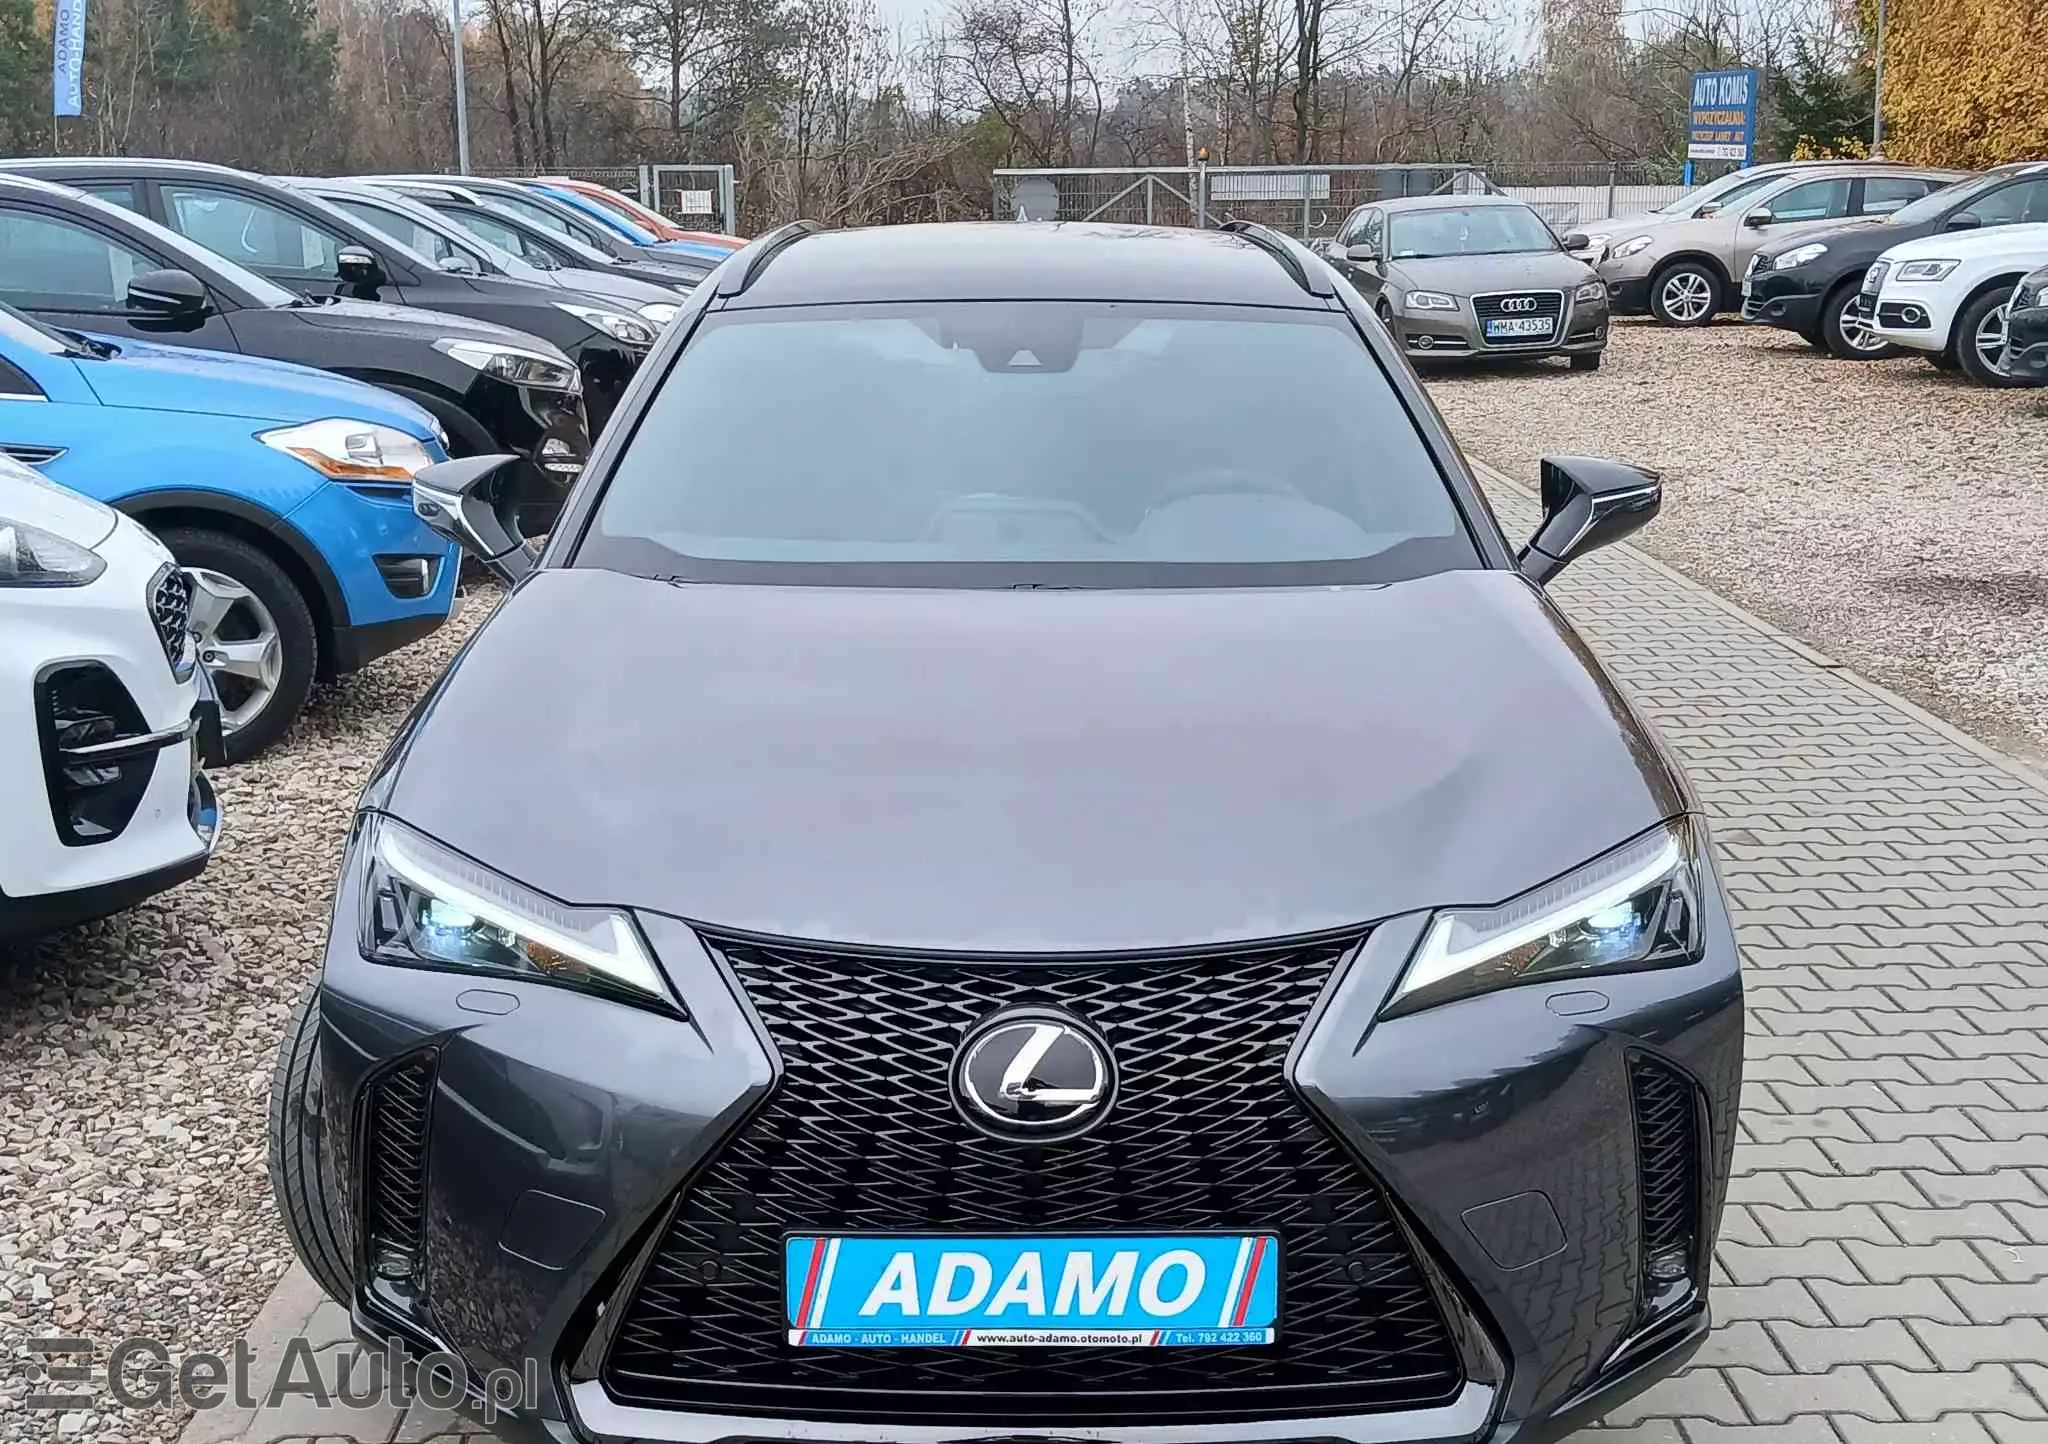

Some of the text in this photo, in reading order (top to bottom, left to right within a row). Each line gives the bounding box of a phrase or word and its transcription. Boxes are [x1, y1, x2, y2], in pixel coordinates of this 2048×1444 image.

[57, 9, 70, 74] ADAMO
[1693, 75, 1749, 107] AUTO KOMIS
[1494, 321, 1515, 333] WMA
[1519, 319, 1551, 332] 43535
[858, 1249, 1207, 1318] ADAMO
[811, 1333, 852, 1344] ADAMO
[861, 1333, 892, 1344] AUTO
[900, 1333, 946, 1344] HANDEL
[976, 1332, 1143, 1346] www.auto-adamo.otomoto.pl
[1175, 1331, 1263, 1343] Tel. 792 422 360
